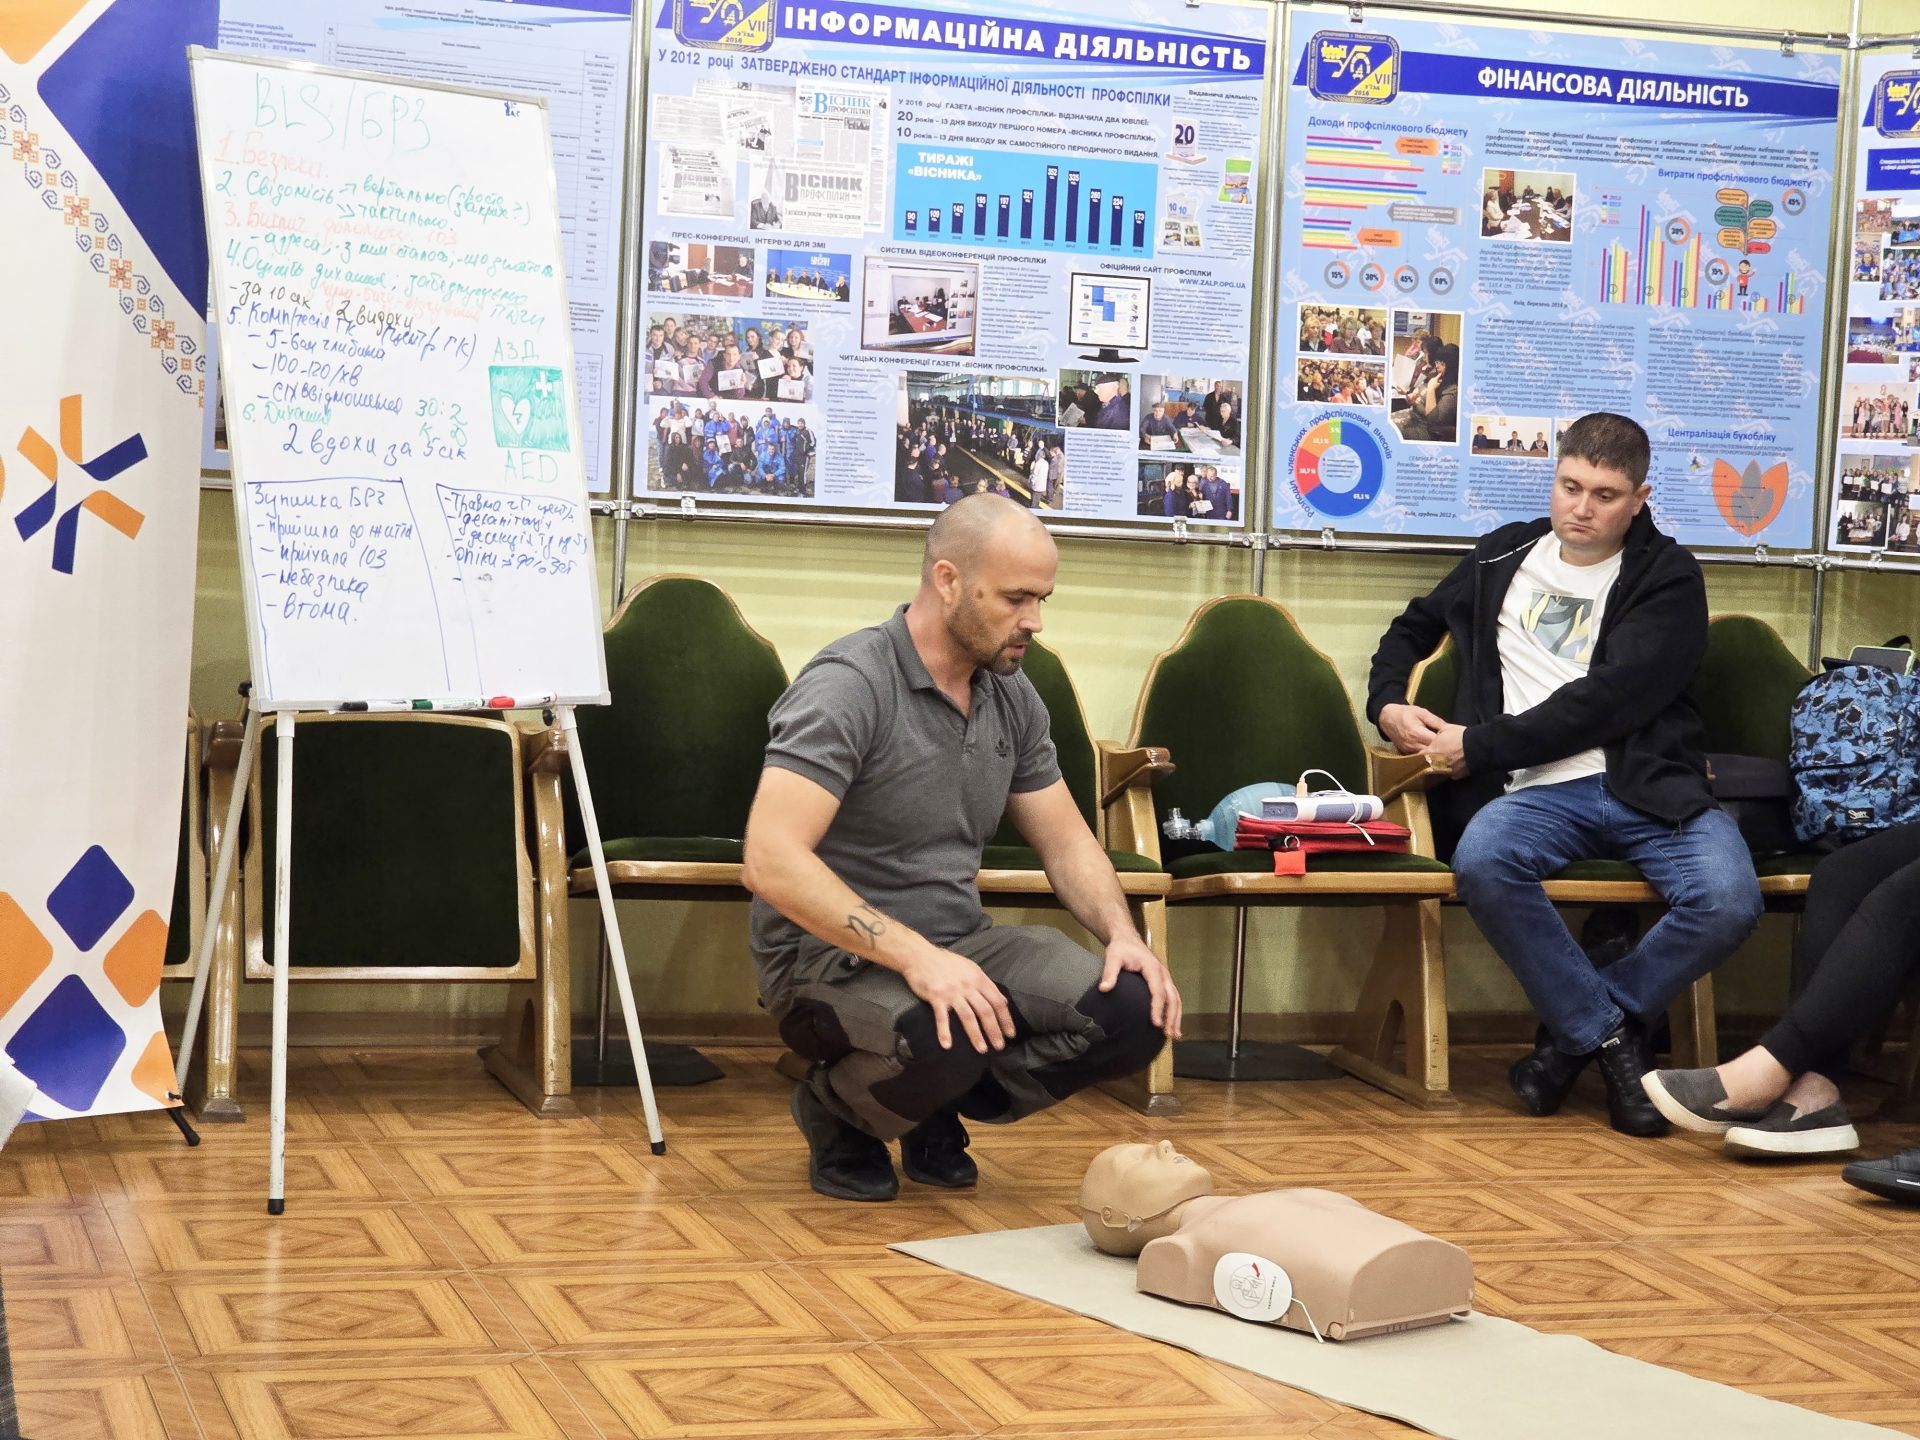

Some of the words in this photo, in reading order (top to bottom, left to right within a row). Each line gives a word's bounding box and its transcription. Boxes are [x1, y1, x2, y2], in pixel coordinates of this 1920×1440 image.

[748, 19, 766, 32] VII
[784, 6, 1045, 53] ІНФОРМАЦІЙНА
[1053, 31, 1251, 71] ДІЯЛЬНІСТЬ
[659, 49, 668, 62] У
[670, 50, 701, 65] 2012
[707, 55, 734, 70] році
[741, 56, 838, 77] ЗАТВЕРДЖЕНО
[841, 65, 907, 84] СТАНДАРТ
[909, 71, 1009, 93] ІНФОРМАЦІЙНОЇ
[1011, 80, 1086, 101] ДІЯЛЬНОСТІ
[1092, 87, 1171, 107] ПРОФСПІЛКИ
[1374, 72, 1391, 85] VII
[1477, 66, 1613, 98] ФІНАНСОВА
[1616, 78, 1750, 108] ДІЯЛЬНІСТЬ
[813, 92, 871, 114] ВІСНИК
[945, 102, 973, 111] ГАЗЕТА
[1058, 112, 1104, 122] ВІДЗНАЧИЛА
[897, 111, 914, 122] 20
[950, 119, 966, 127] ДНЯ
[968, 121, 998, 130] ВИХОДУ
[1000, 123, 1035, 133] ПЕРШОГО
[1036, 126, 1067, 135] НОМЕРА
[1308, 116, 1345, 130] Доходи
[1347, 120, 1423, 135] профспілкового
[1425, 124, 1468, 138] бюджету
[896, 127, 912, 138] 10
[948, 135, 964, 143] ДНЯ
[966, 137, 996, 146] ВИХОДУ
[1009, 140, 1066, 151] САМОСТІЙНОГО
[1067, 145, 1123, 155] ПЕРІОДИЧНОГО
[1174, 124, 1195, 145] 20
[918, 151, 974, 167] ТИРАЖІ
[907, 166, 982, 181] «ВІСНИКА»
[1658, 168, 1694, 180] Витрати
[1696, 172, 1769, 185] профспілкового
[1771, 175, 1811, 188] бюджету
[785, 172, 863, 202] ВІСНИК
[794, 240, 810, 249] ДЛЯ
[880, 246, 917, 256] СИСТЕМА
[919, 249, 996, 261] ВІДЕОКОНФЕРЕНЦІЙ
[997, 255, 1047, 265] ПРОФСПІЛКИ
[1100, 262, 1141, 272] ОФІЦІЙНИЙ
[1143, 264, 1162, 274] САЙТ
[1163, 268, 1212, 277] ПРОФСПІЛКИ
[839, 354, 877, 363] ЧИТАЦЬКІ
[878, 357, 930, 367] КОНФЕРЕНЦІЇ
[931, 360, 960, 368] ГАЗЕТИ
[1309, 408, 1372, 428] профспілкових
[1373, 427, 1393, 460] внесків
[1668, 428, 1731, 441] Централізація
[1733, 431, 1776, 443] бухобліку
[503, 449, 559, 484] AED
